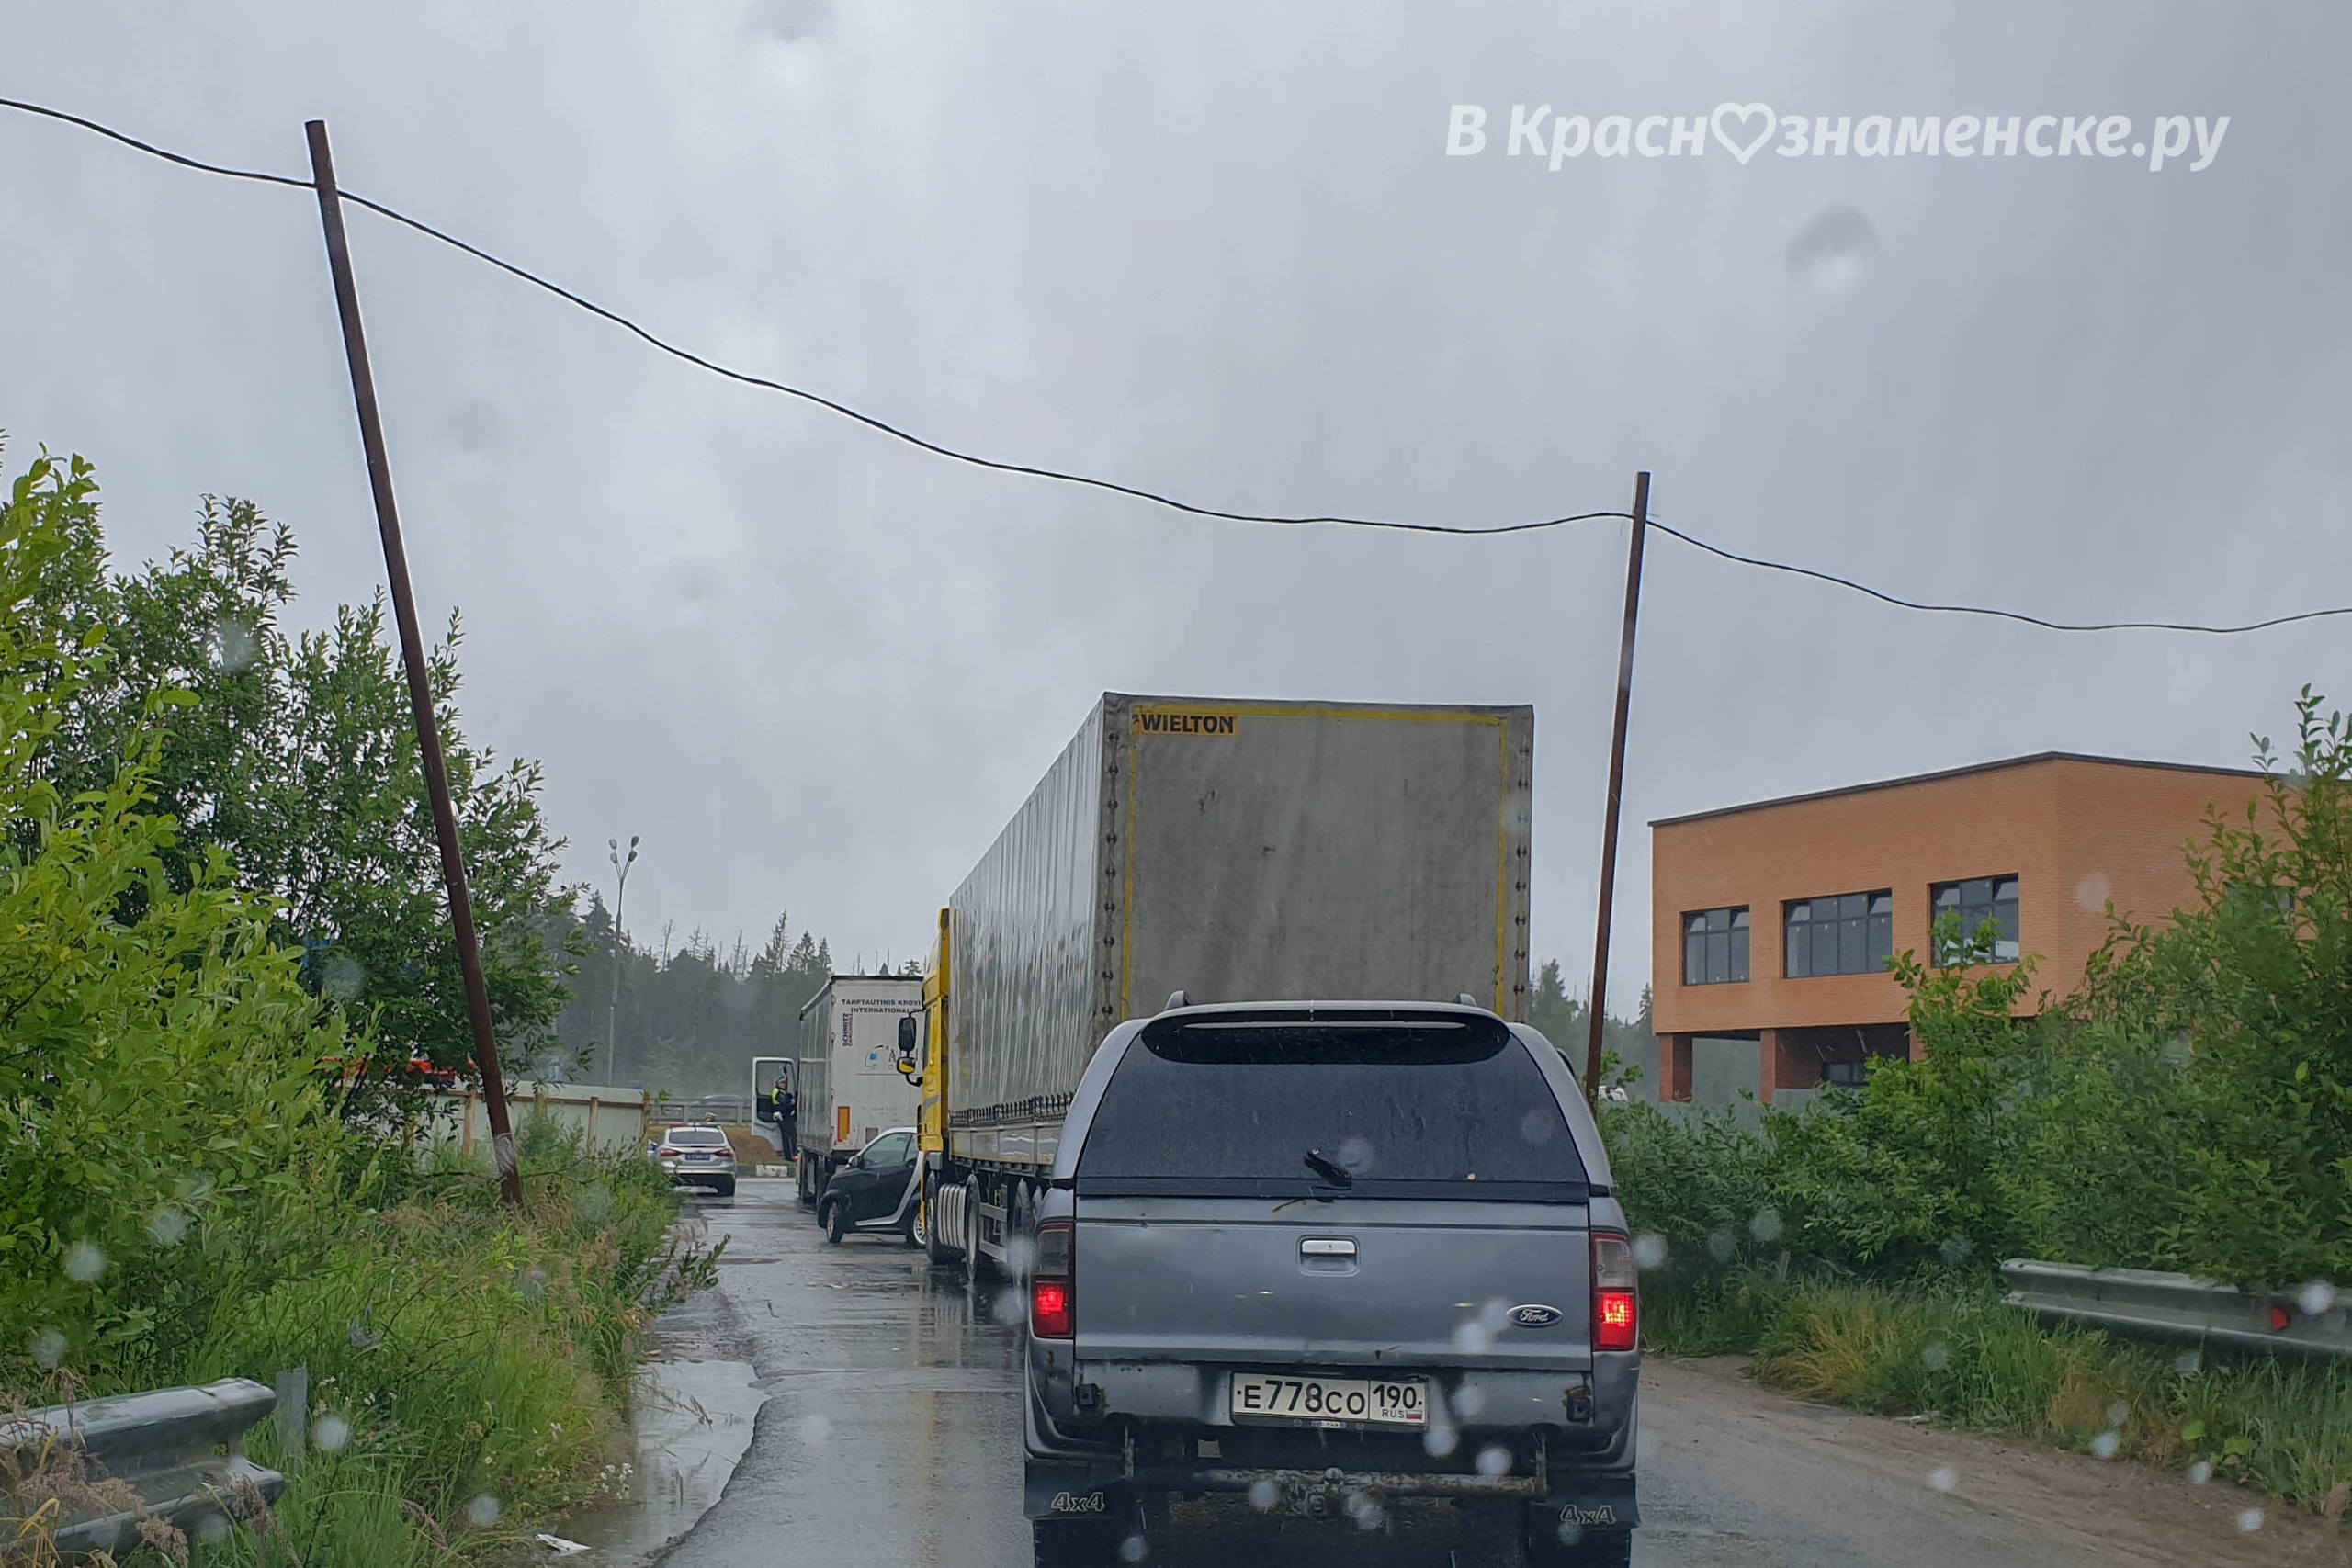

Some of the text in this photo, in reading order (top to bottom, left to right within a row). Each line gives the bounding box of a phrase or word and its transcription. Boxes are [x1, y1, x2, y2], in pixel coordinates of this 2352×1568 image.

[1140, 714, 1234, 734] WIELTON
[1519, 1309, 1550, 1322] Ford
[1372, 1384, 1418, 1410] 190
[1381, 1408, 1405, 1418] RUS
[1051, 1492, 1105, 1512] 4x4
[1560, 1504, 1617, 1525] 4x4
